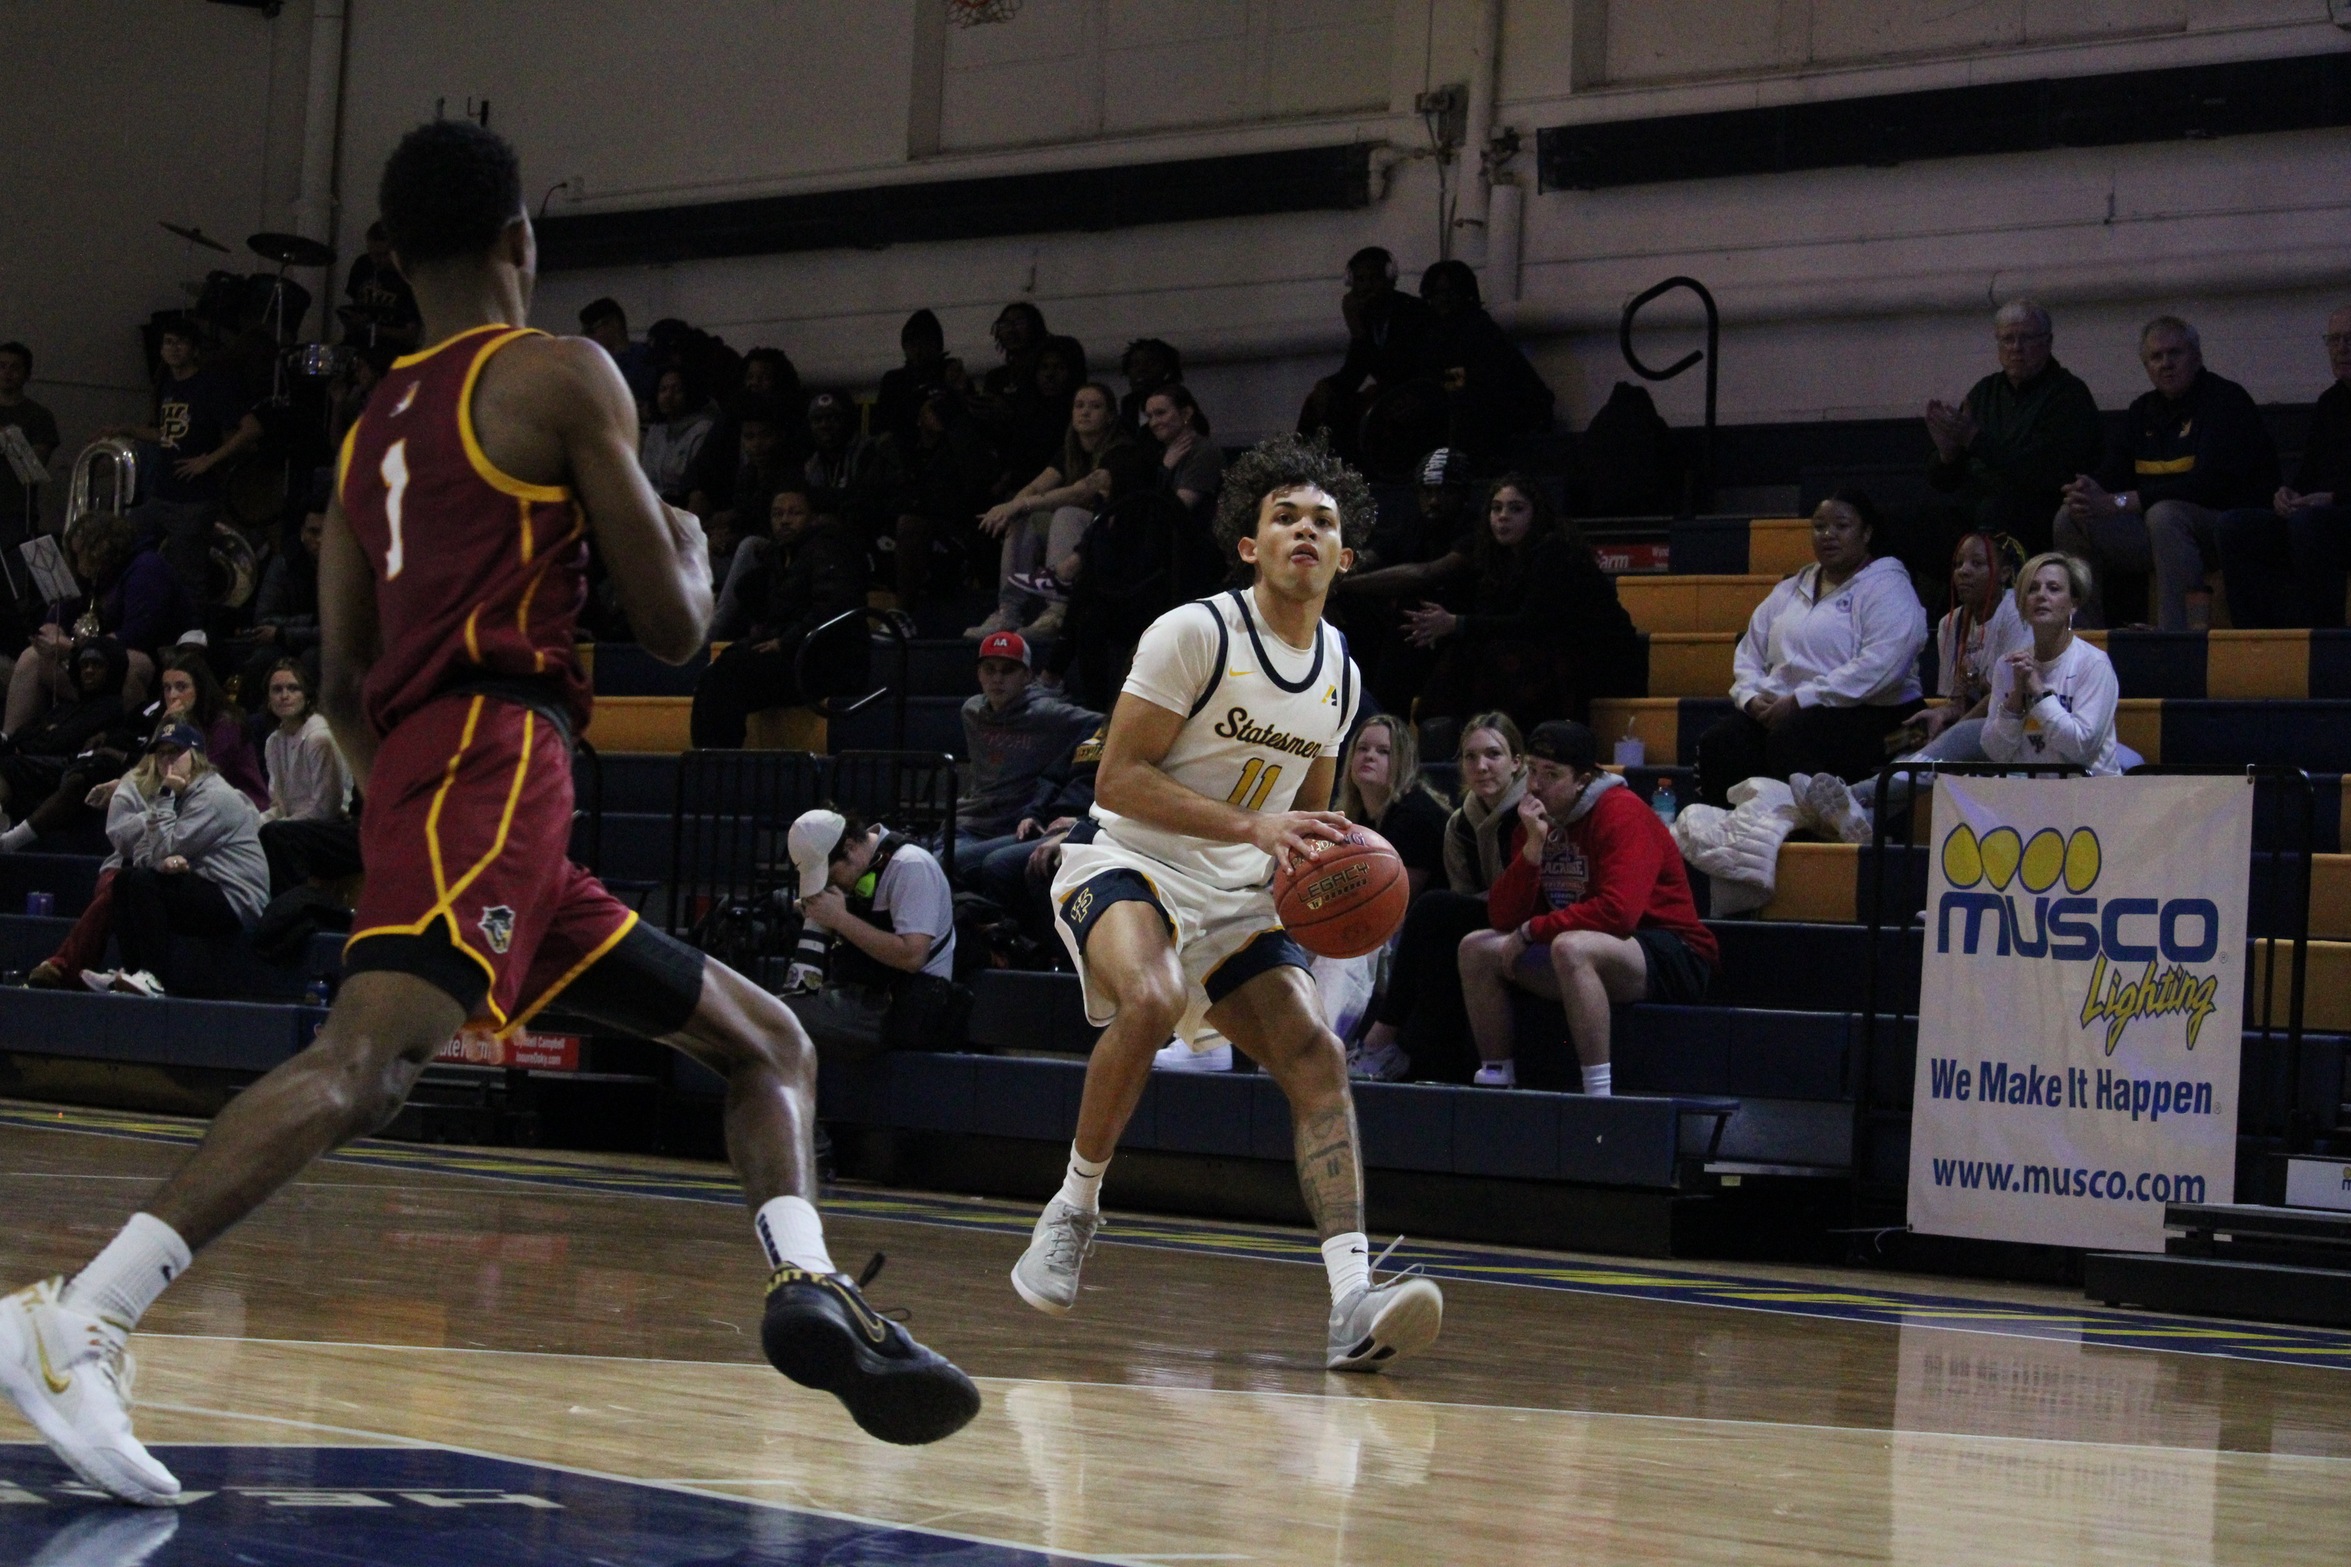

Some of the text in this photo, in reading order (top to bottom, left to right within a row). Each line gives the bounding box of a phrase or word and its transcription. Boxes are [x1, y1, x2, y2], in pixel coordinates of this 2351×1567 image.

[379, 437, 410, 581] 1
[1214, 707, 1323, 759] Statesmen
[1227, 757, 1283, 811] 11
[1297, 862, 1369, 903] LEGACY
[1937, 891, 2219, 963] MUSCO
[2080, 951, 2218, 1056] Lighting
[1930, 1058, 2212, 1121] We Make It Happen
[1932, 1158, 2206, 1202] www.musco.com
